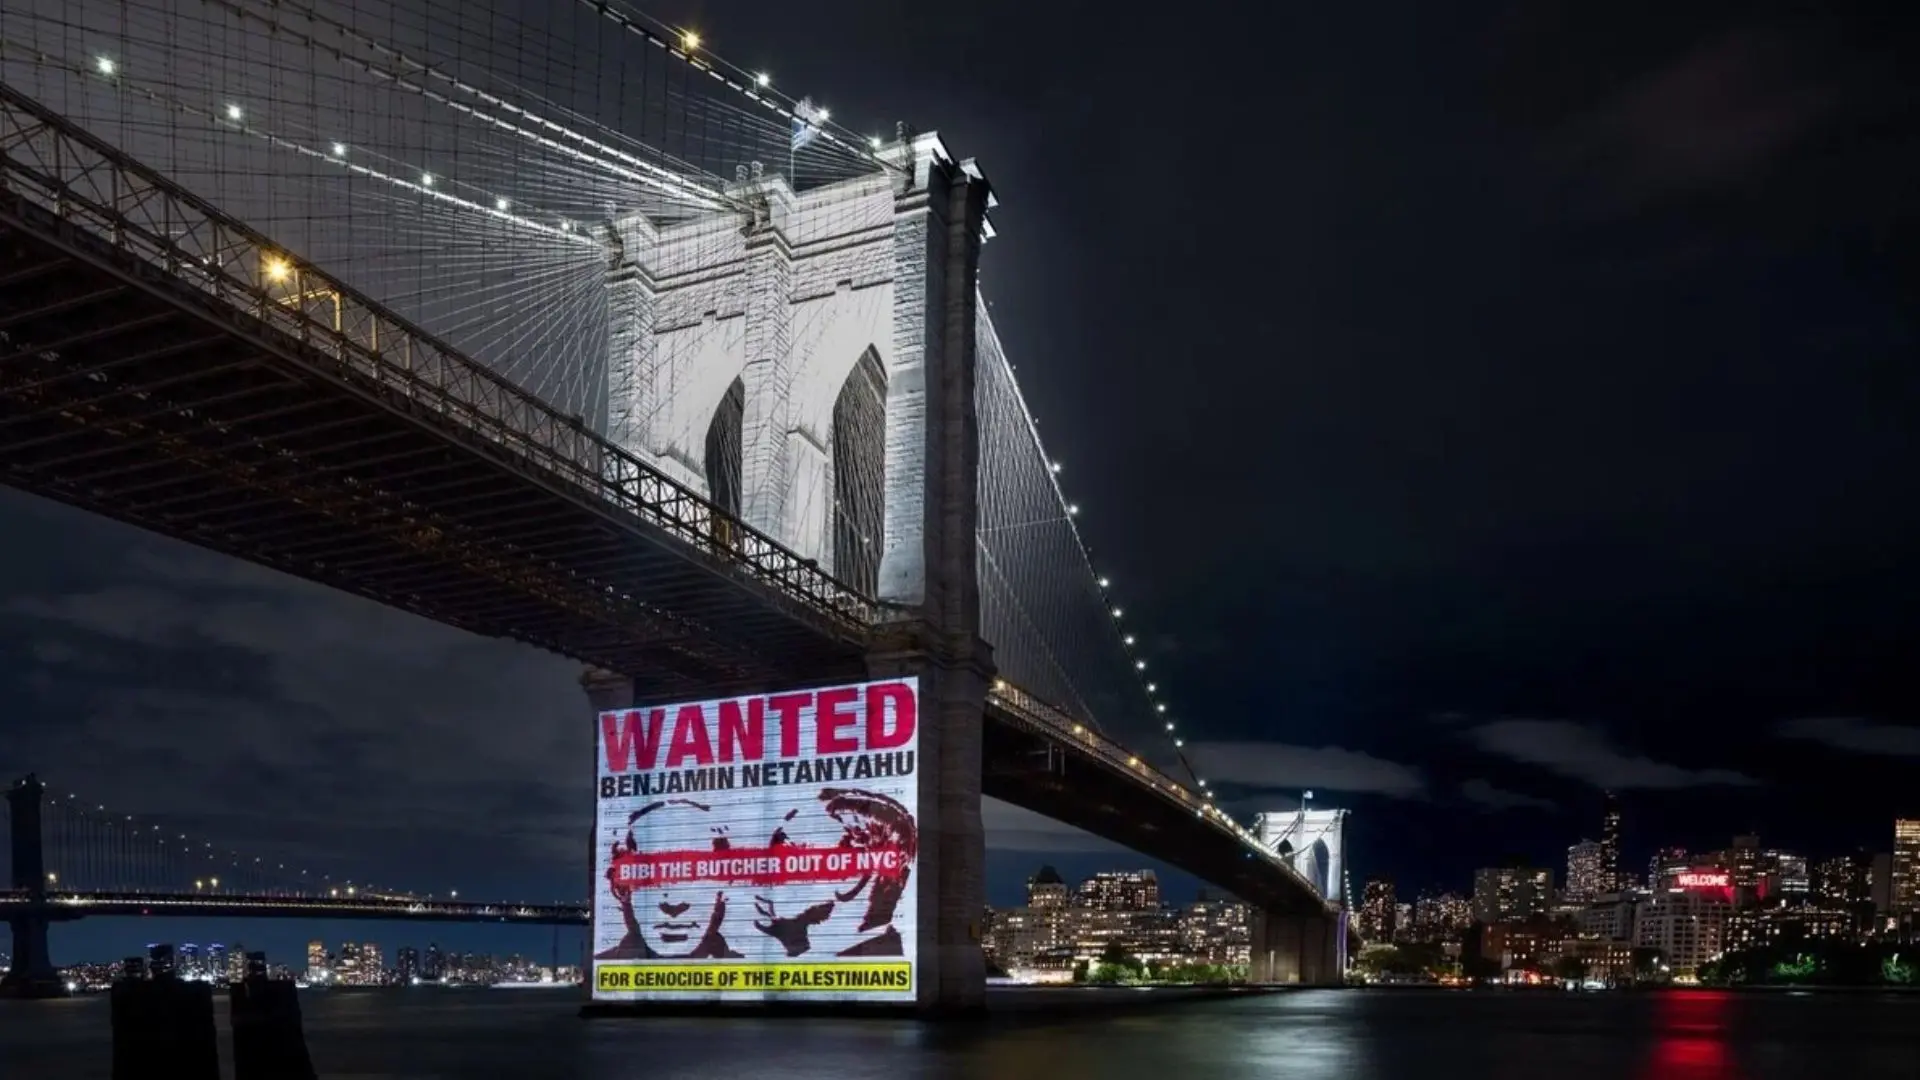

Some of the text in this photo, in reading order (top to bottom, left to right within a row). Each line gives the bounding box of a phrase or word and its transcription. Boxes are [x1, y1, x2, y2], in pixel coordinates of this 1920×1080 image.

[601, 682, 916, 773] WANTED
[600, 751, 915, 799] BENJAMIN NETANYAHU
[620, 851, 897, 880] BIBI THE BUTCHER OUT OF NYC
[1678, 873, 1729, 887] WELCOME
[600, 969, 908, 987] FOR GENOCIDE OF THE PALESTINIANS
